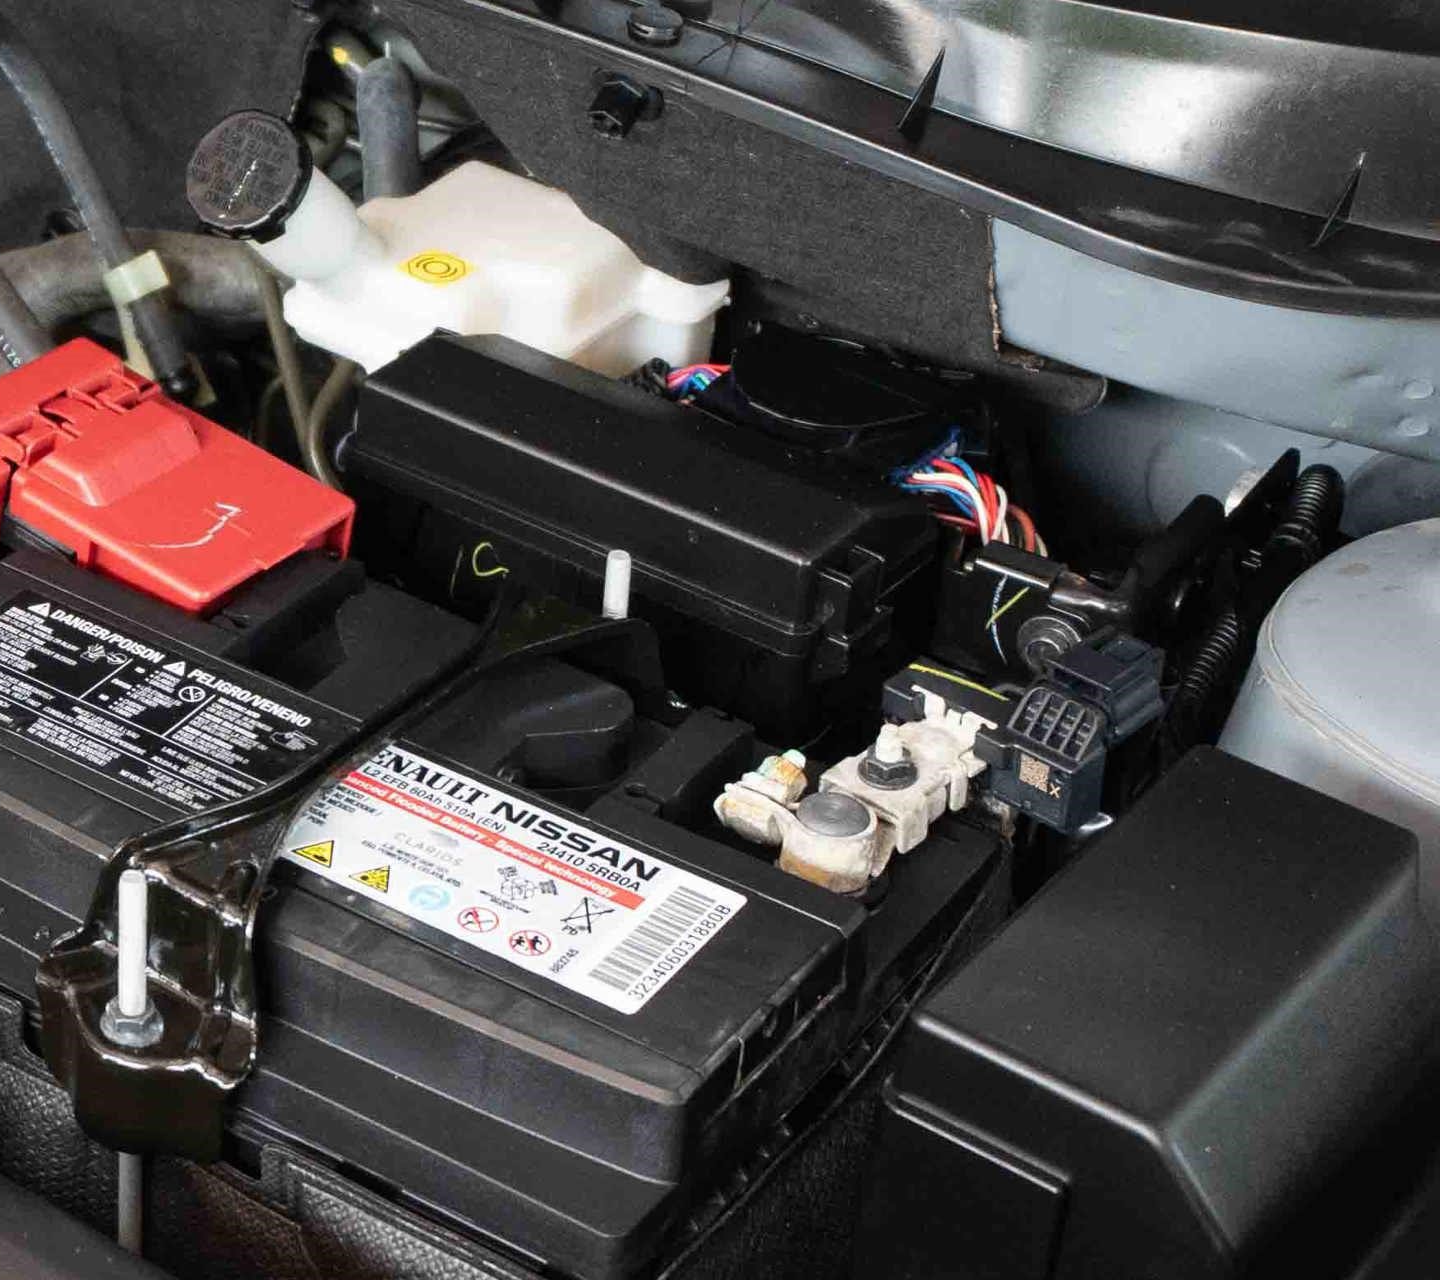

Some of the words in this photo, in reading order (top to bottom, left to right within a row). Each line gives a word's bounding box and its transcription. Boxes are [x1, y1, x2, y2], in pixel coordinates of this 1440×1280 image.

[47, 607, 167, 665] DANGER/POISON
[185, 667, 314, 729] PELIGRO/VENENO
[366, 746, 490, 808] ENAULT
[488, 799, 661, 882] NISSAN
[379, 772, 410, 790] EFB
[407, 785, 445, 806] 60Ah
[474, 814, 509, 834] (EN)
[535, 839, 587, 867] 24410
[391, 829, 465, 867] CLARIOS
[559, 923, 581, 937] Pb
